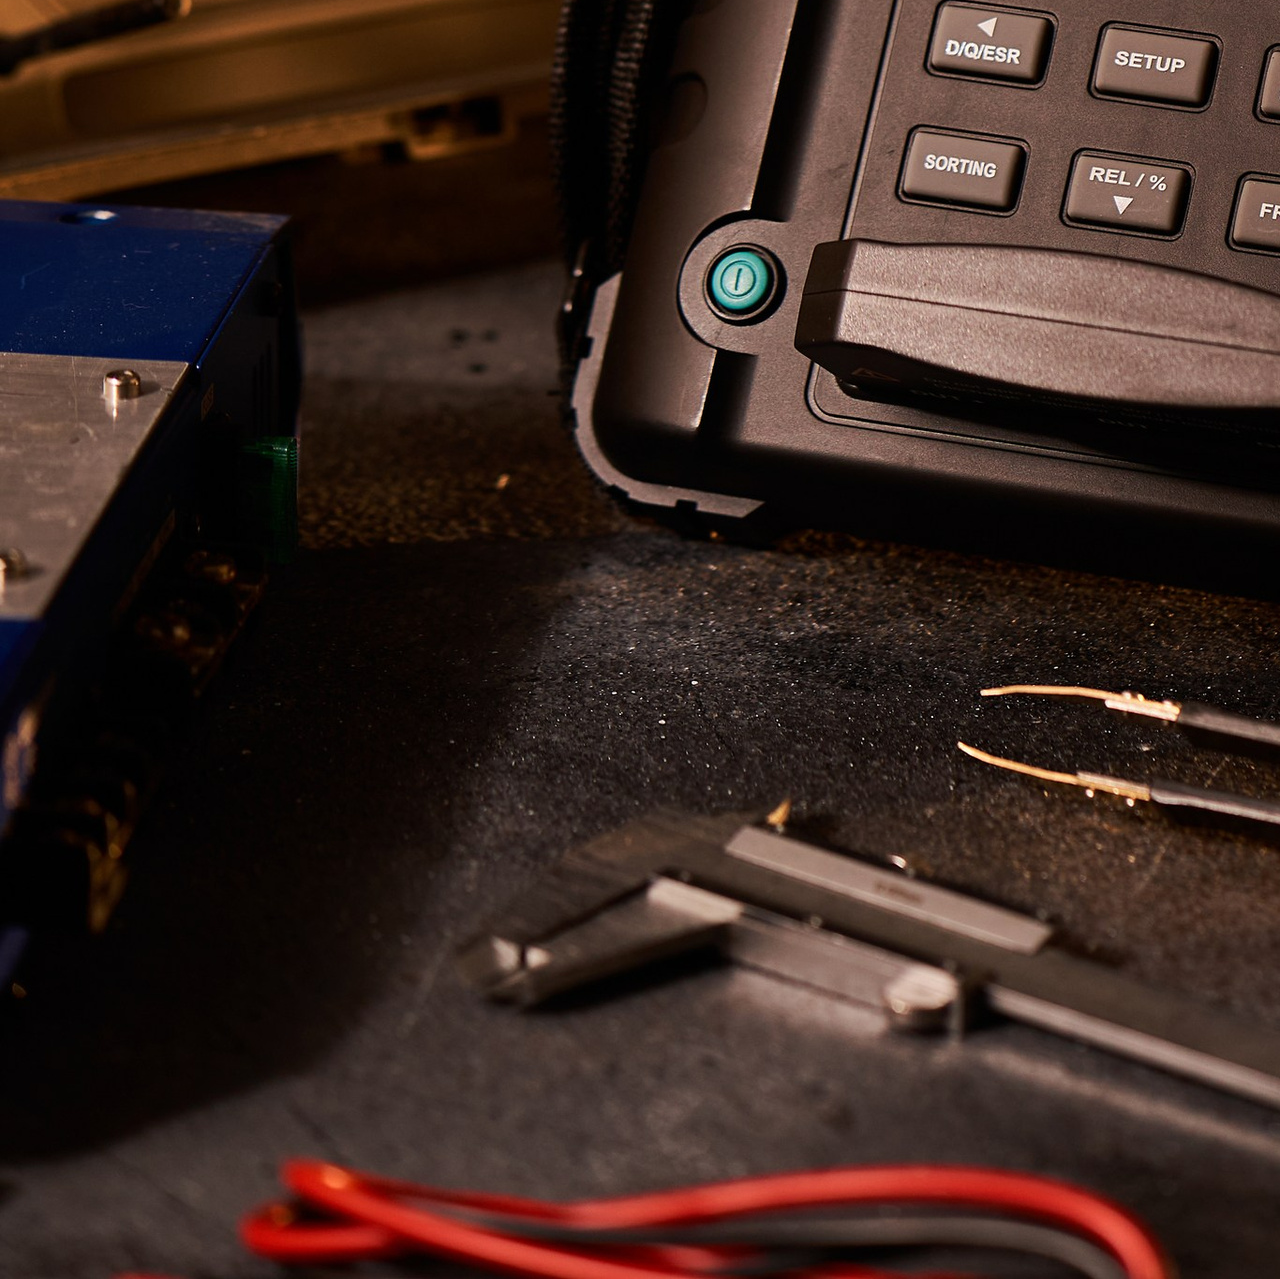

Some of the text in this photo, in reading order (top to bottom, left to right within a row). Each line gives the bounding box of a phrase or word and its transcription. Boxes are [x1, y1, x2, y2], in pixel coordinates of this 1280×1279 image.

[944, 38, 1021, 65] D/Q/ESR
[1114, 51, 1186, 74] SETUP
[924, 154, 997, 179] SORTING
[1088, 165, 1130, 188] REL
